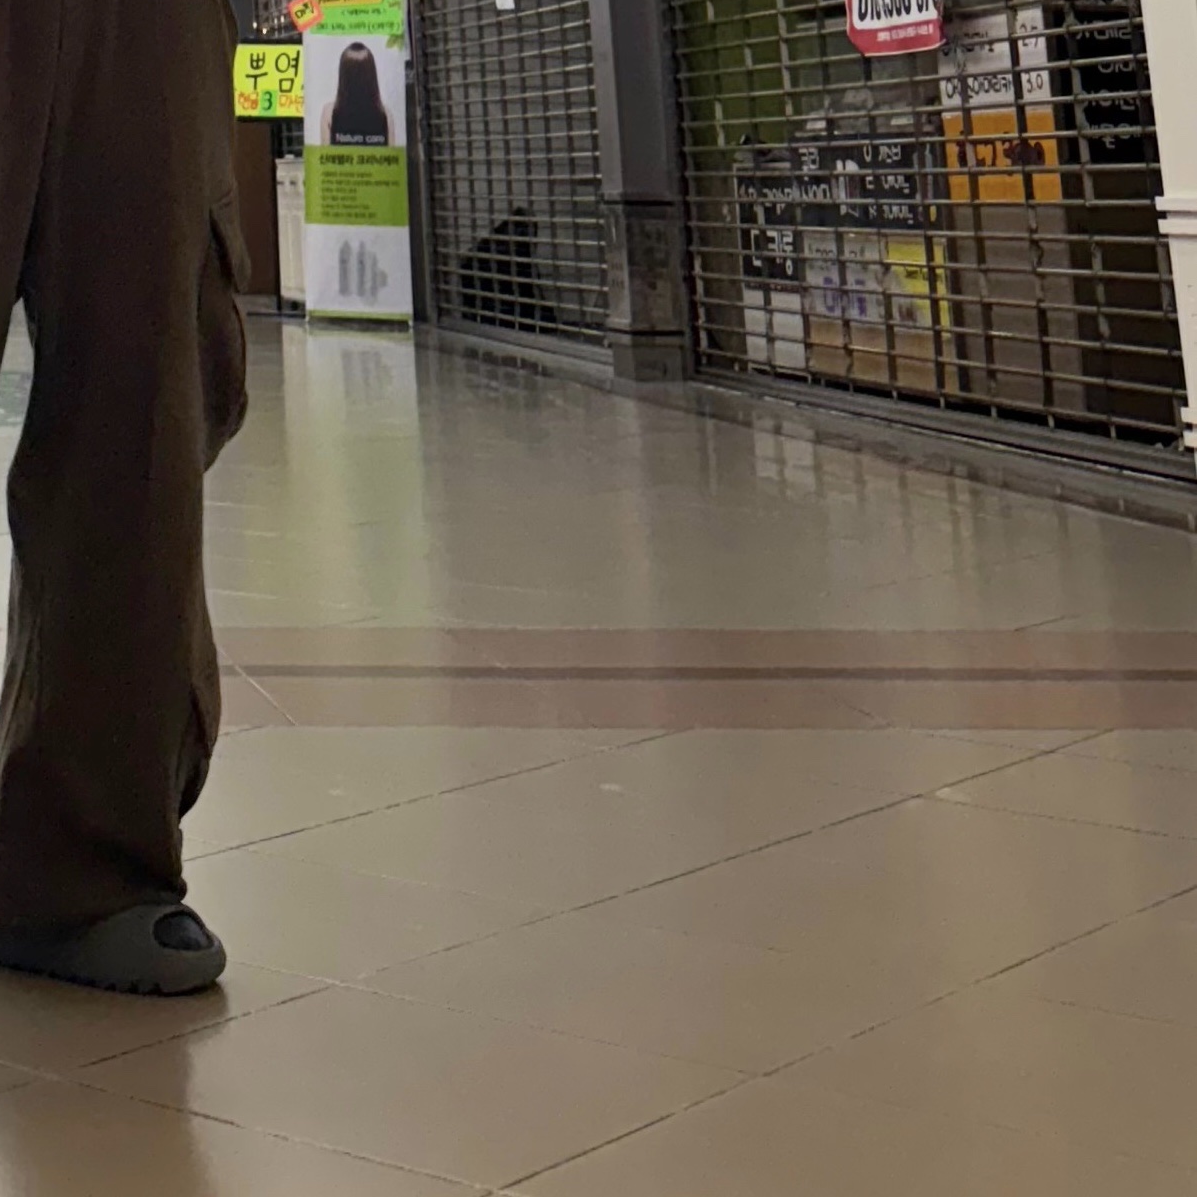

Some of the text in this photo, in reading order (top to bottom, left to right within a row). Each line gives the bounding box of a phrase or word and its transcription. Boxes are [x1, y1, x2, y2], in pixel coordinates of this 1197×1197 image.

[245, 49, 300, 93] 뿌염
[1025, 72, 1044, 94] 3.0
[261, 90, 273, 111] 3
